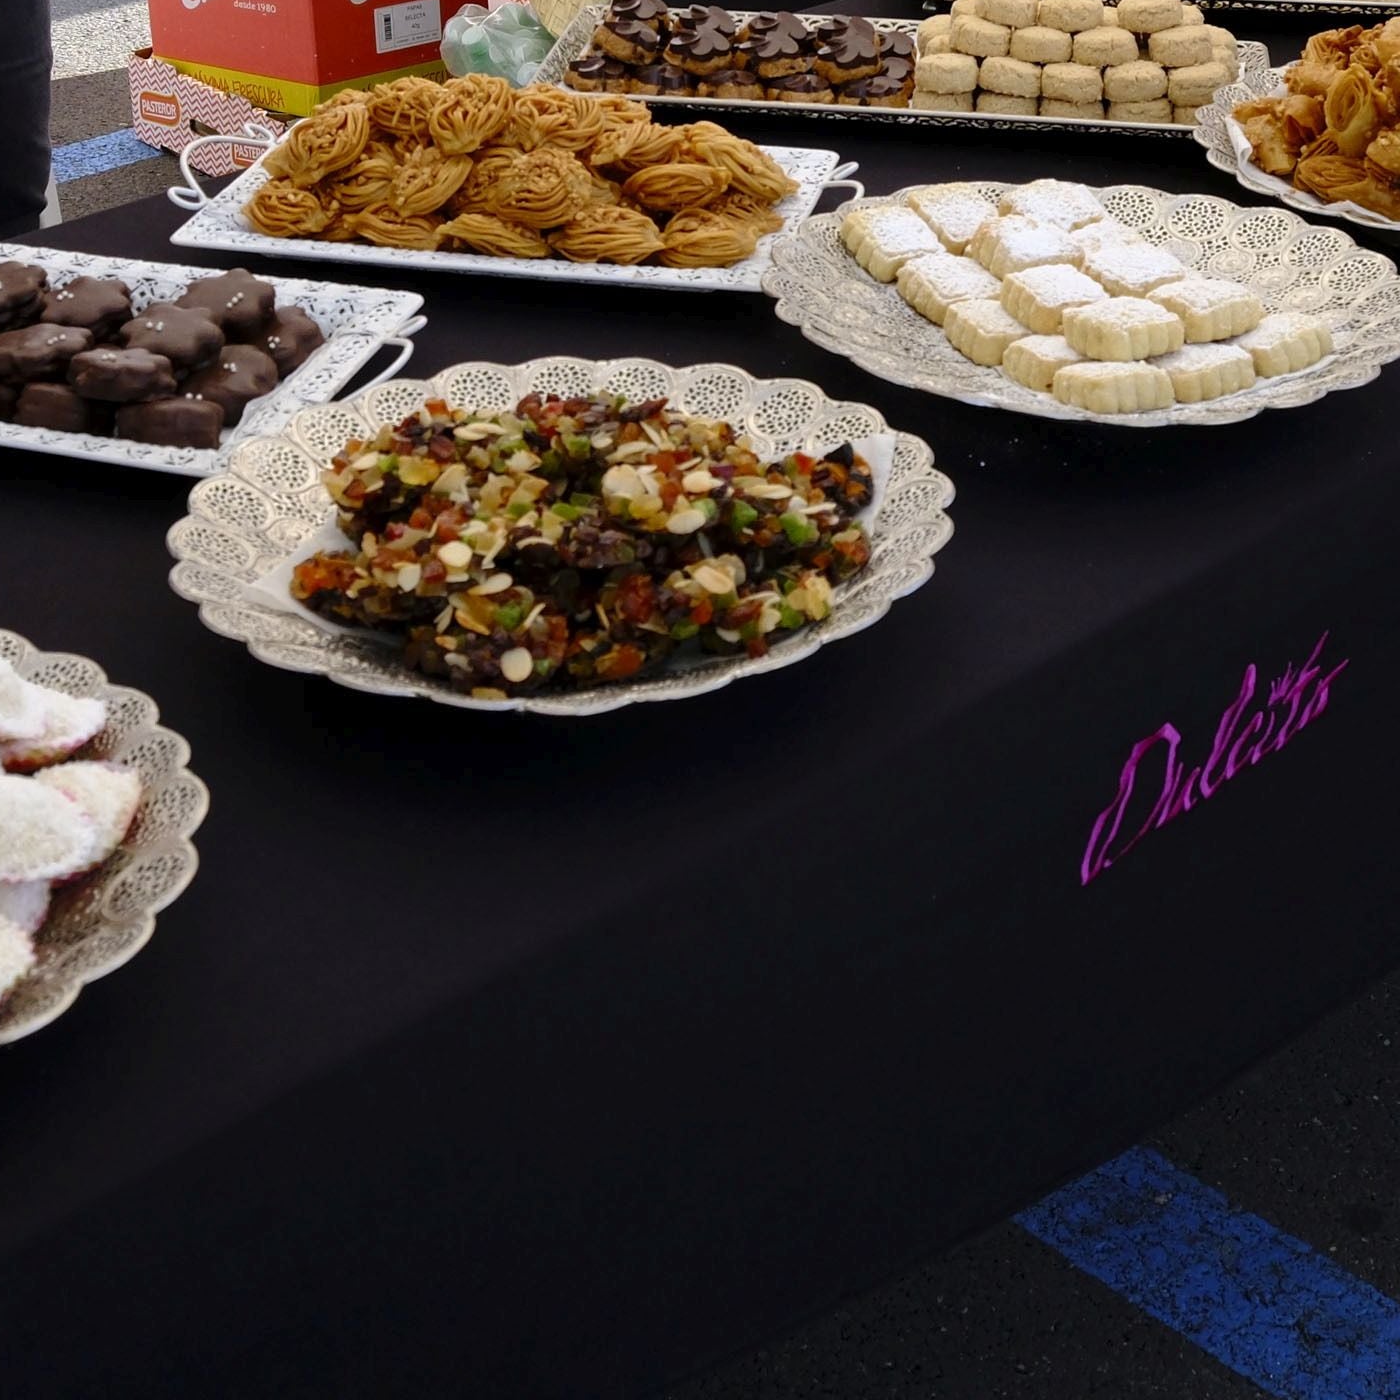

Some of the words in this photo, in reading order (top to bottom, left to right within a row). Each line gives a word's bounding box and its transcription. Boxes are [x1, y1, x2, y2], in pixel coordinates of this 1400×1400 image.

[233, 0, 256, 11] desde
[256, 2, 277, 14] 1980
[141, 99, 177, 117] PASTEROR
[233, 143, 267, 159] PASTERO
[1080, 629, 1350, 886] Dulcito
